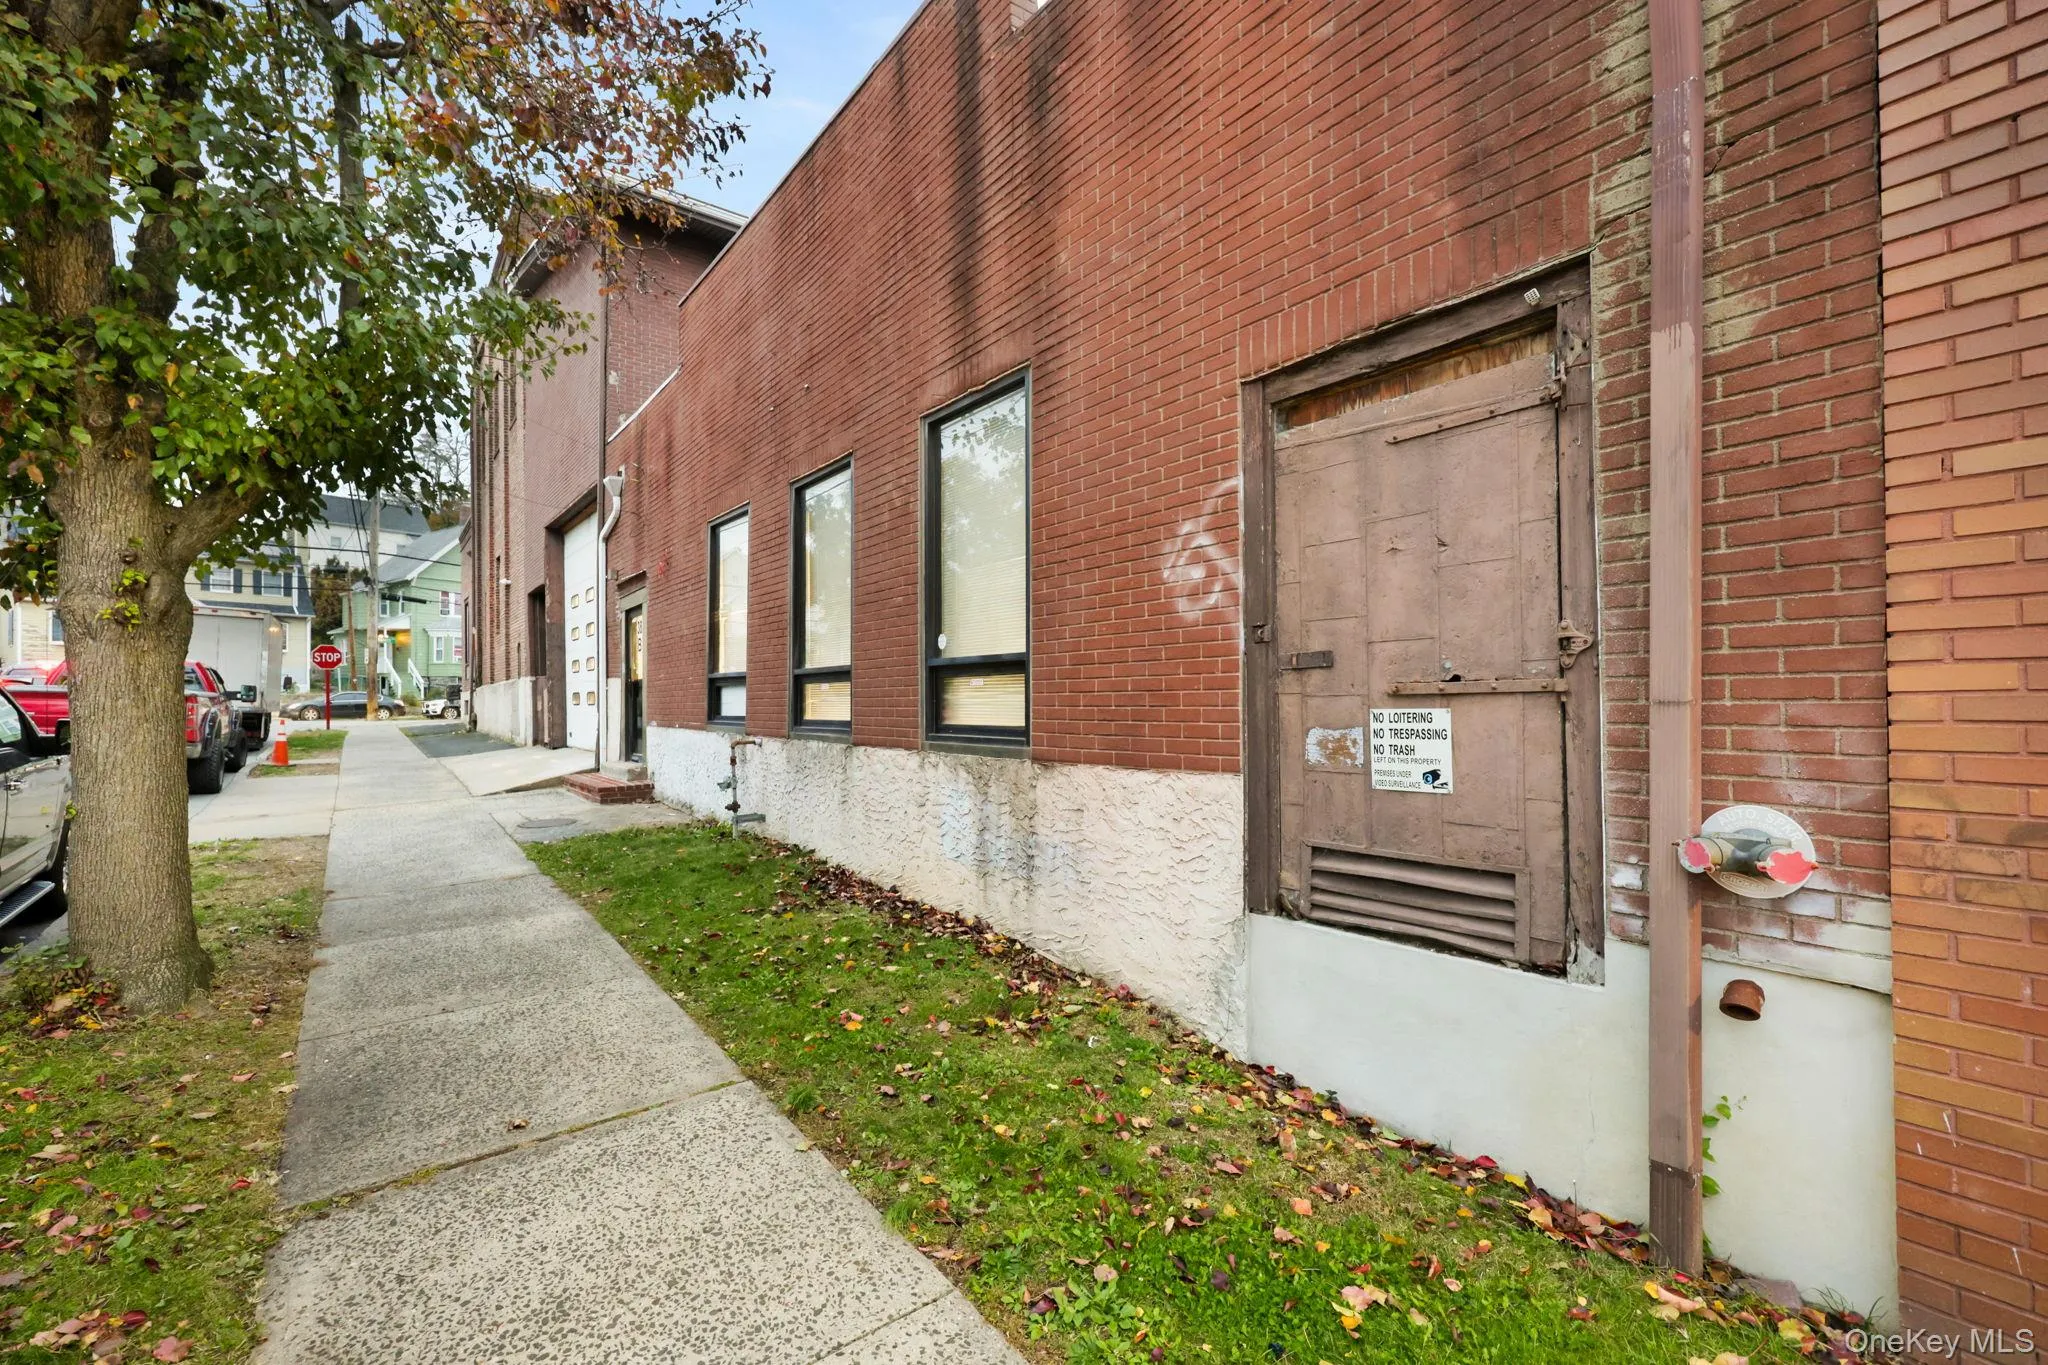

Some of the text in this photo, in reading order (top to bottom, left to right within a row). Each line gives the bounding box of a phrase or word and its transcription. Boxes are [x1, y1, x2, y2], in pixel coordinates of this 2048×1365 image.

[314, 652, 340, 662] STOP
[1373, 712, 1433, 723] NO LOITERING
[1373, 728, 1447, 740] NO TRESPASSING
[1373, 744, 1415, 755] NO TRASH
[1374, 769, 1412, 778] PREMISES UNDER
[1388, 780, 1421, 789] SURVEILLANCE
